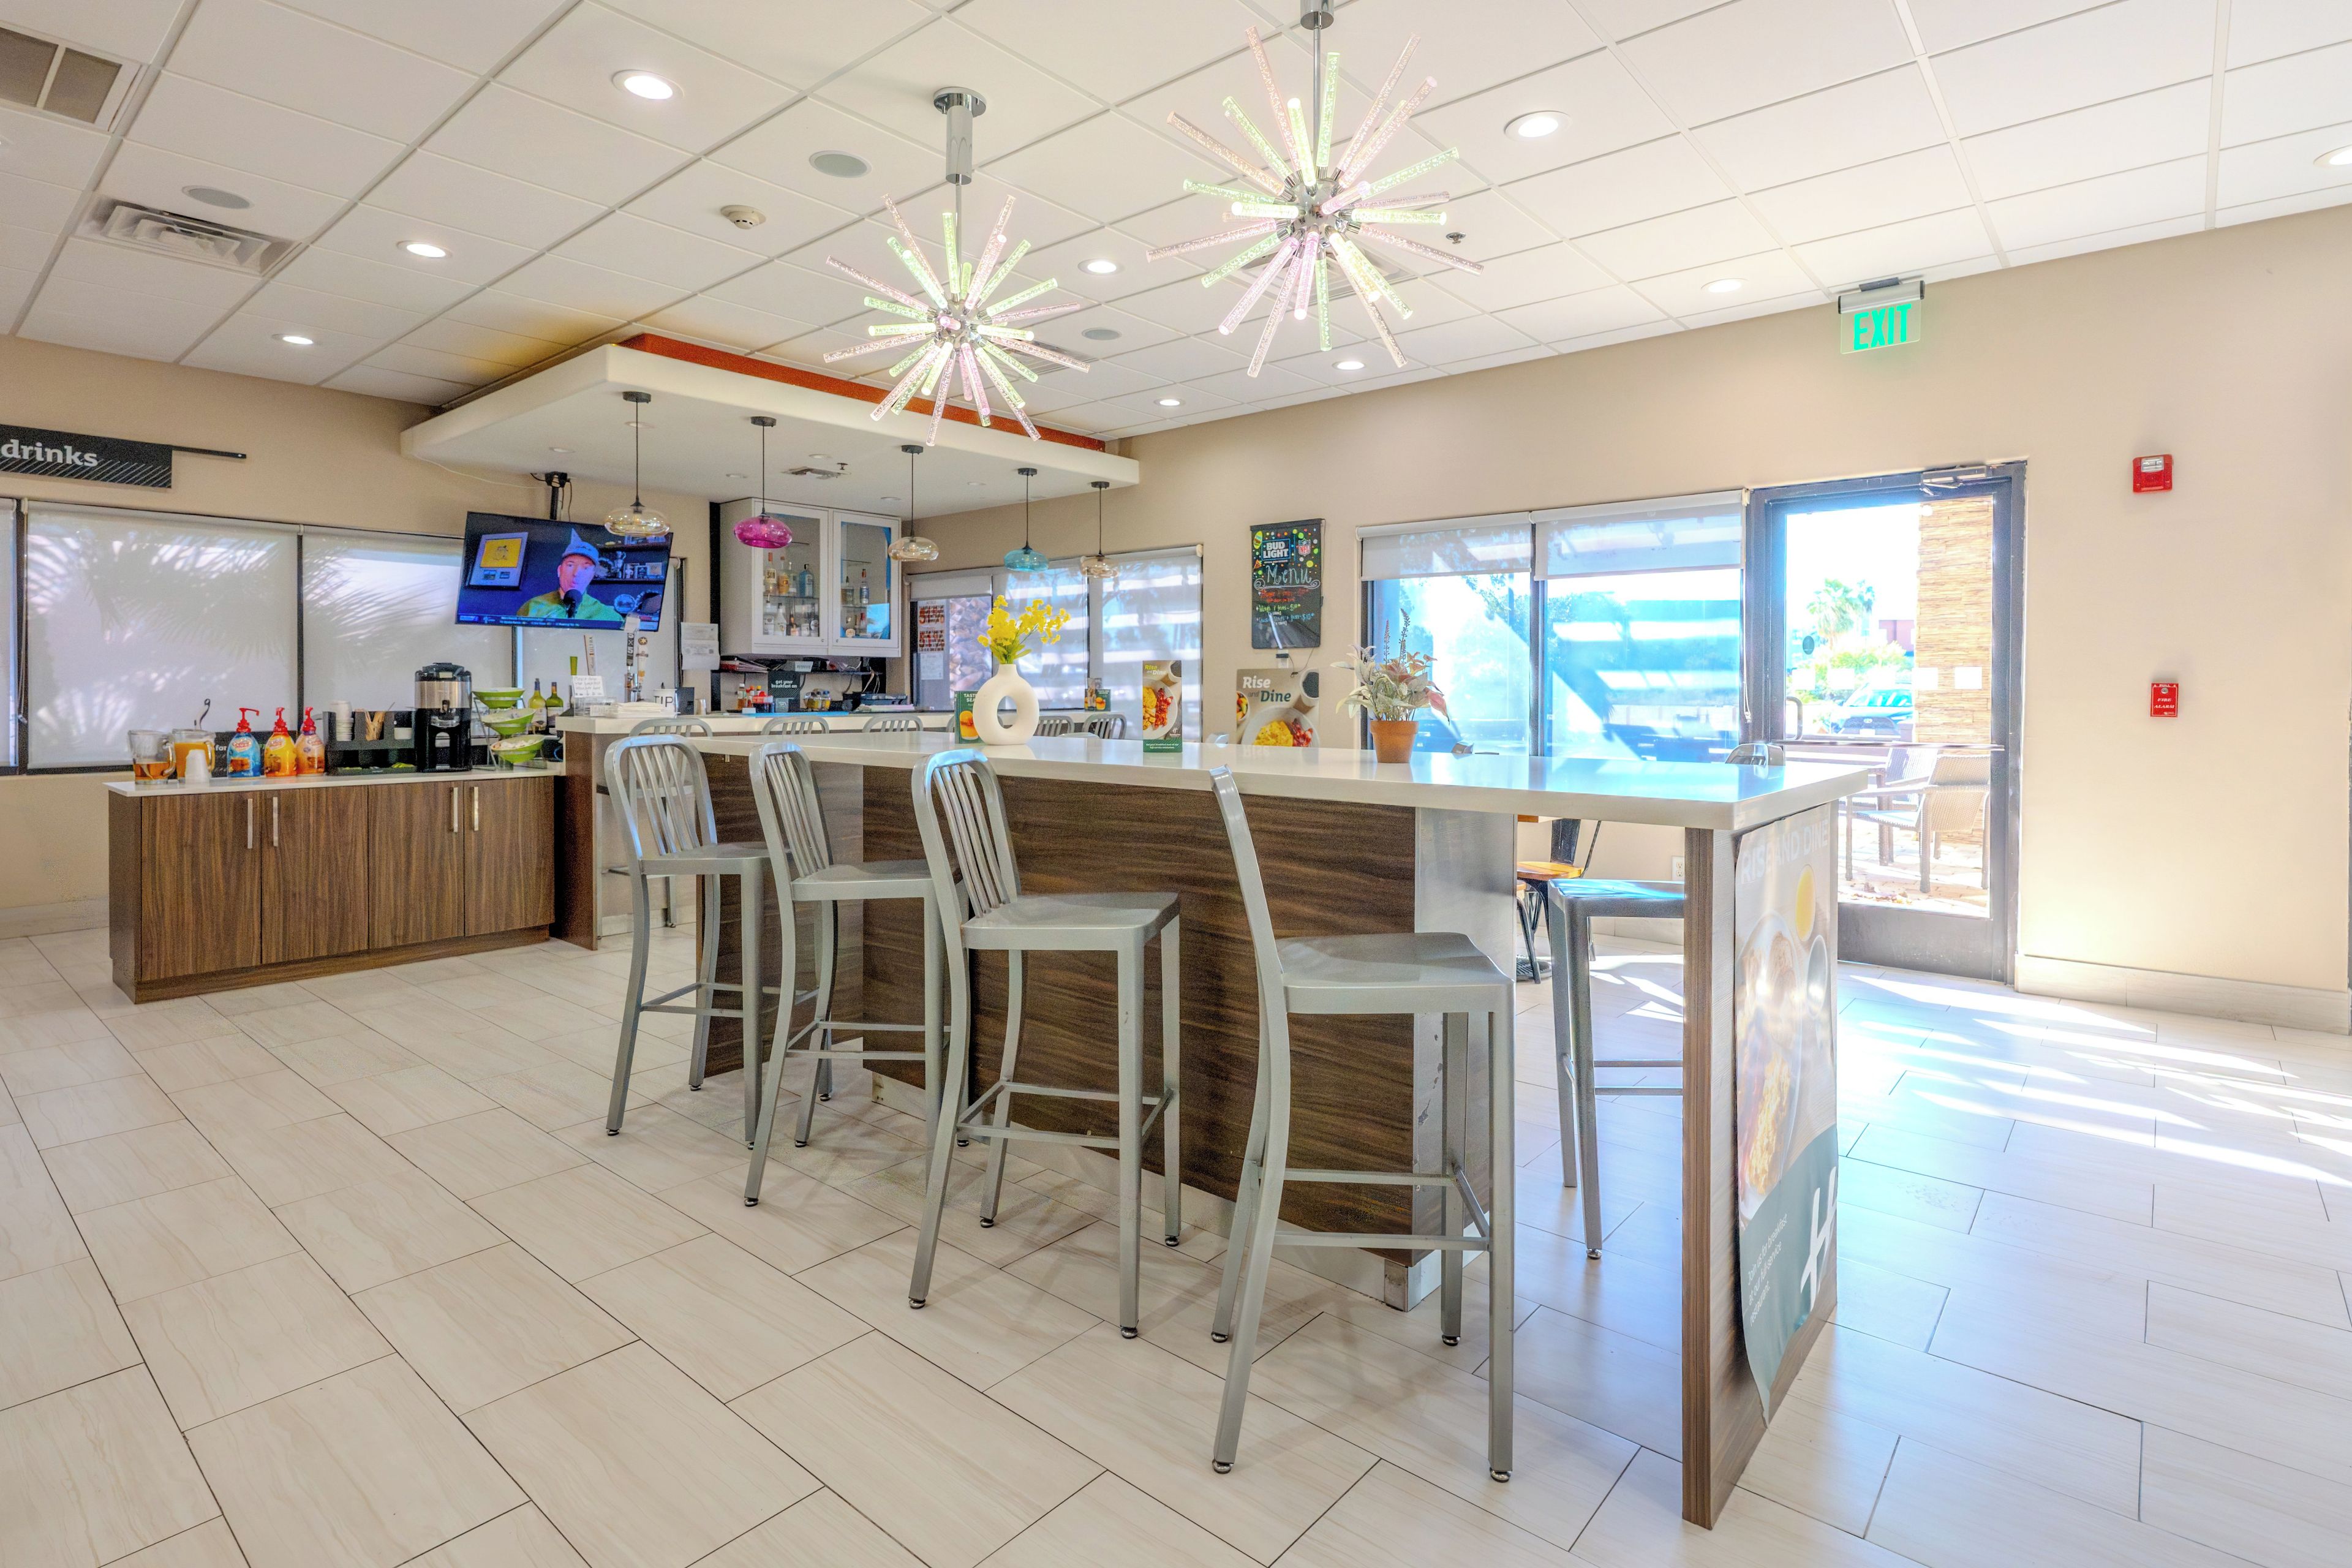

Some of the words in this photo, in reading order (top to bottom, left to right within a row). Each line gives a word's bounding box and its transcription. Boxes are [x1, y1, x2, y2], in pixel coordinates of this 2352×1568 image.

[1853, 304, 1912, 350] EXIT
[1, 439, 98, 467] drinks
[1266, 541, 1285, 551] BUD
[1263, 549, 1289, 559] LIGHT
[1266, 565, 1312, 585] Menu
[1243, 676, 1271, 688] Rise
[654, 696, 674, 707] TIP
[1261, 690, 1291, 702] Dine
[1741, 843, 1773, 884] RISE
[1774, 831, 1800, 866] AND
[1804, 819, 1828, 855] DINE
[1748, 1264, 1757, 1285] Join
[1768, 1213, 1787, 1248] breakfast
[1749, 1291, 1754, 1305] at
